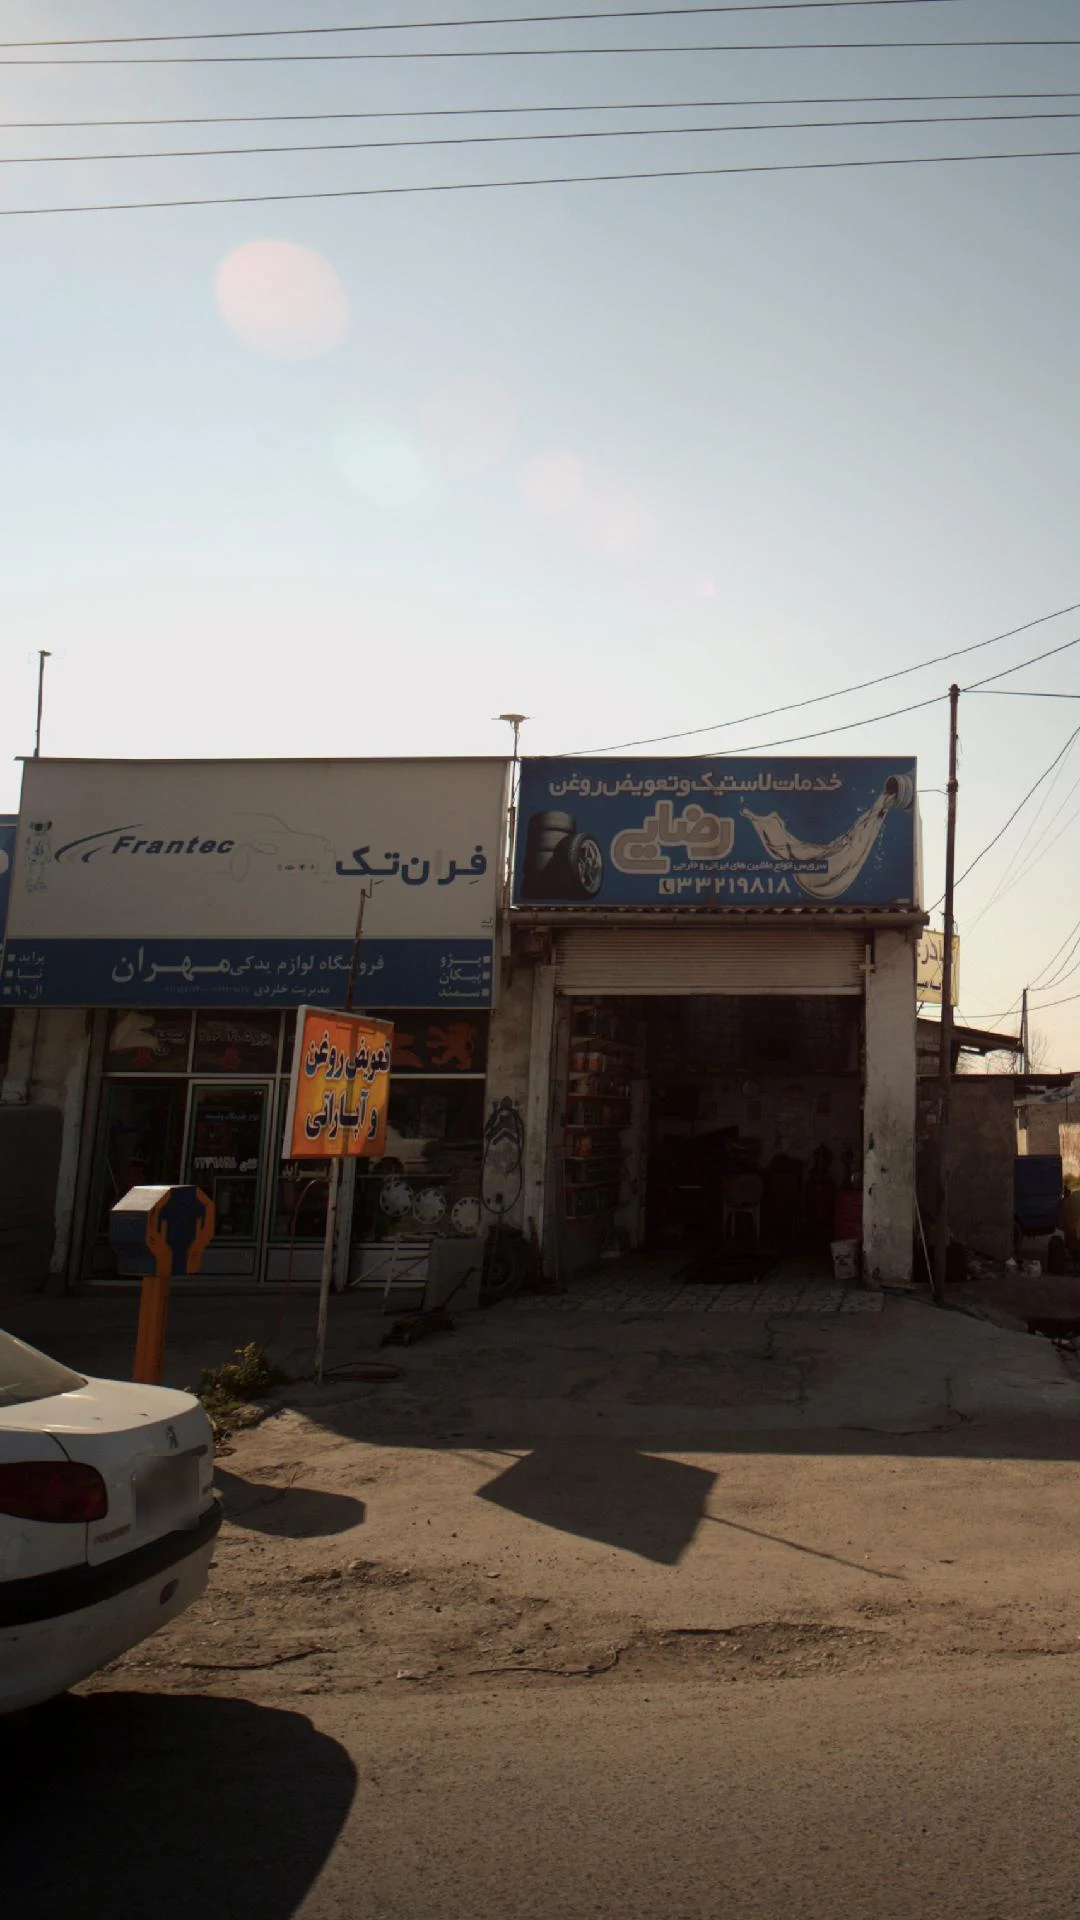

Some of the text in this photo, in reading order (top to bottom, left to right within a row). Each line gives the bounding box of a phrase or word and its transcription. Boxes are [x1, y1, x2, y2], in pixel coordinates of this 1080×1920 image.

[548, 773, 602, 796] روغن
[603, 773, 679, 797] تعویض
[691, 772, 772, 796] لاستیک
[773, 773, 843, 791] خدمات
[111, 835, 235, 855] Frantec
[676, 877, 791, 894] ۳۳۲۱۹۸۱۸
[111, 945, 230, 982] مهران
[230, 955, 271, 976] یدکی
[277, 954, 314, 976] لوازم
[440, 951, 482, 968] پژو
[439, 968, 482, 984] پیکان
[291, 983, 330, 998] مدیریت
[437, 985, 481, 999] سمند
[305, 1030, 392, 1083] تعویض روغن
[305, 1088, 379, 1141] و آپاراتی
